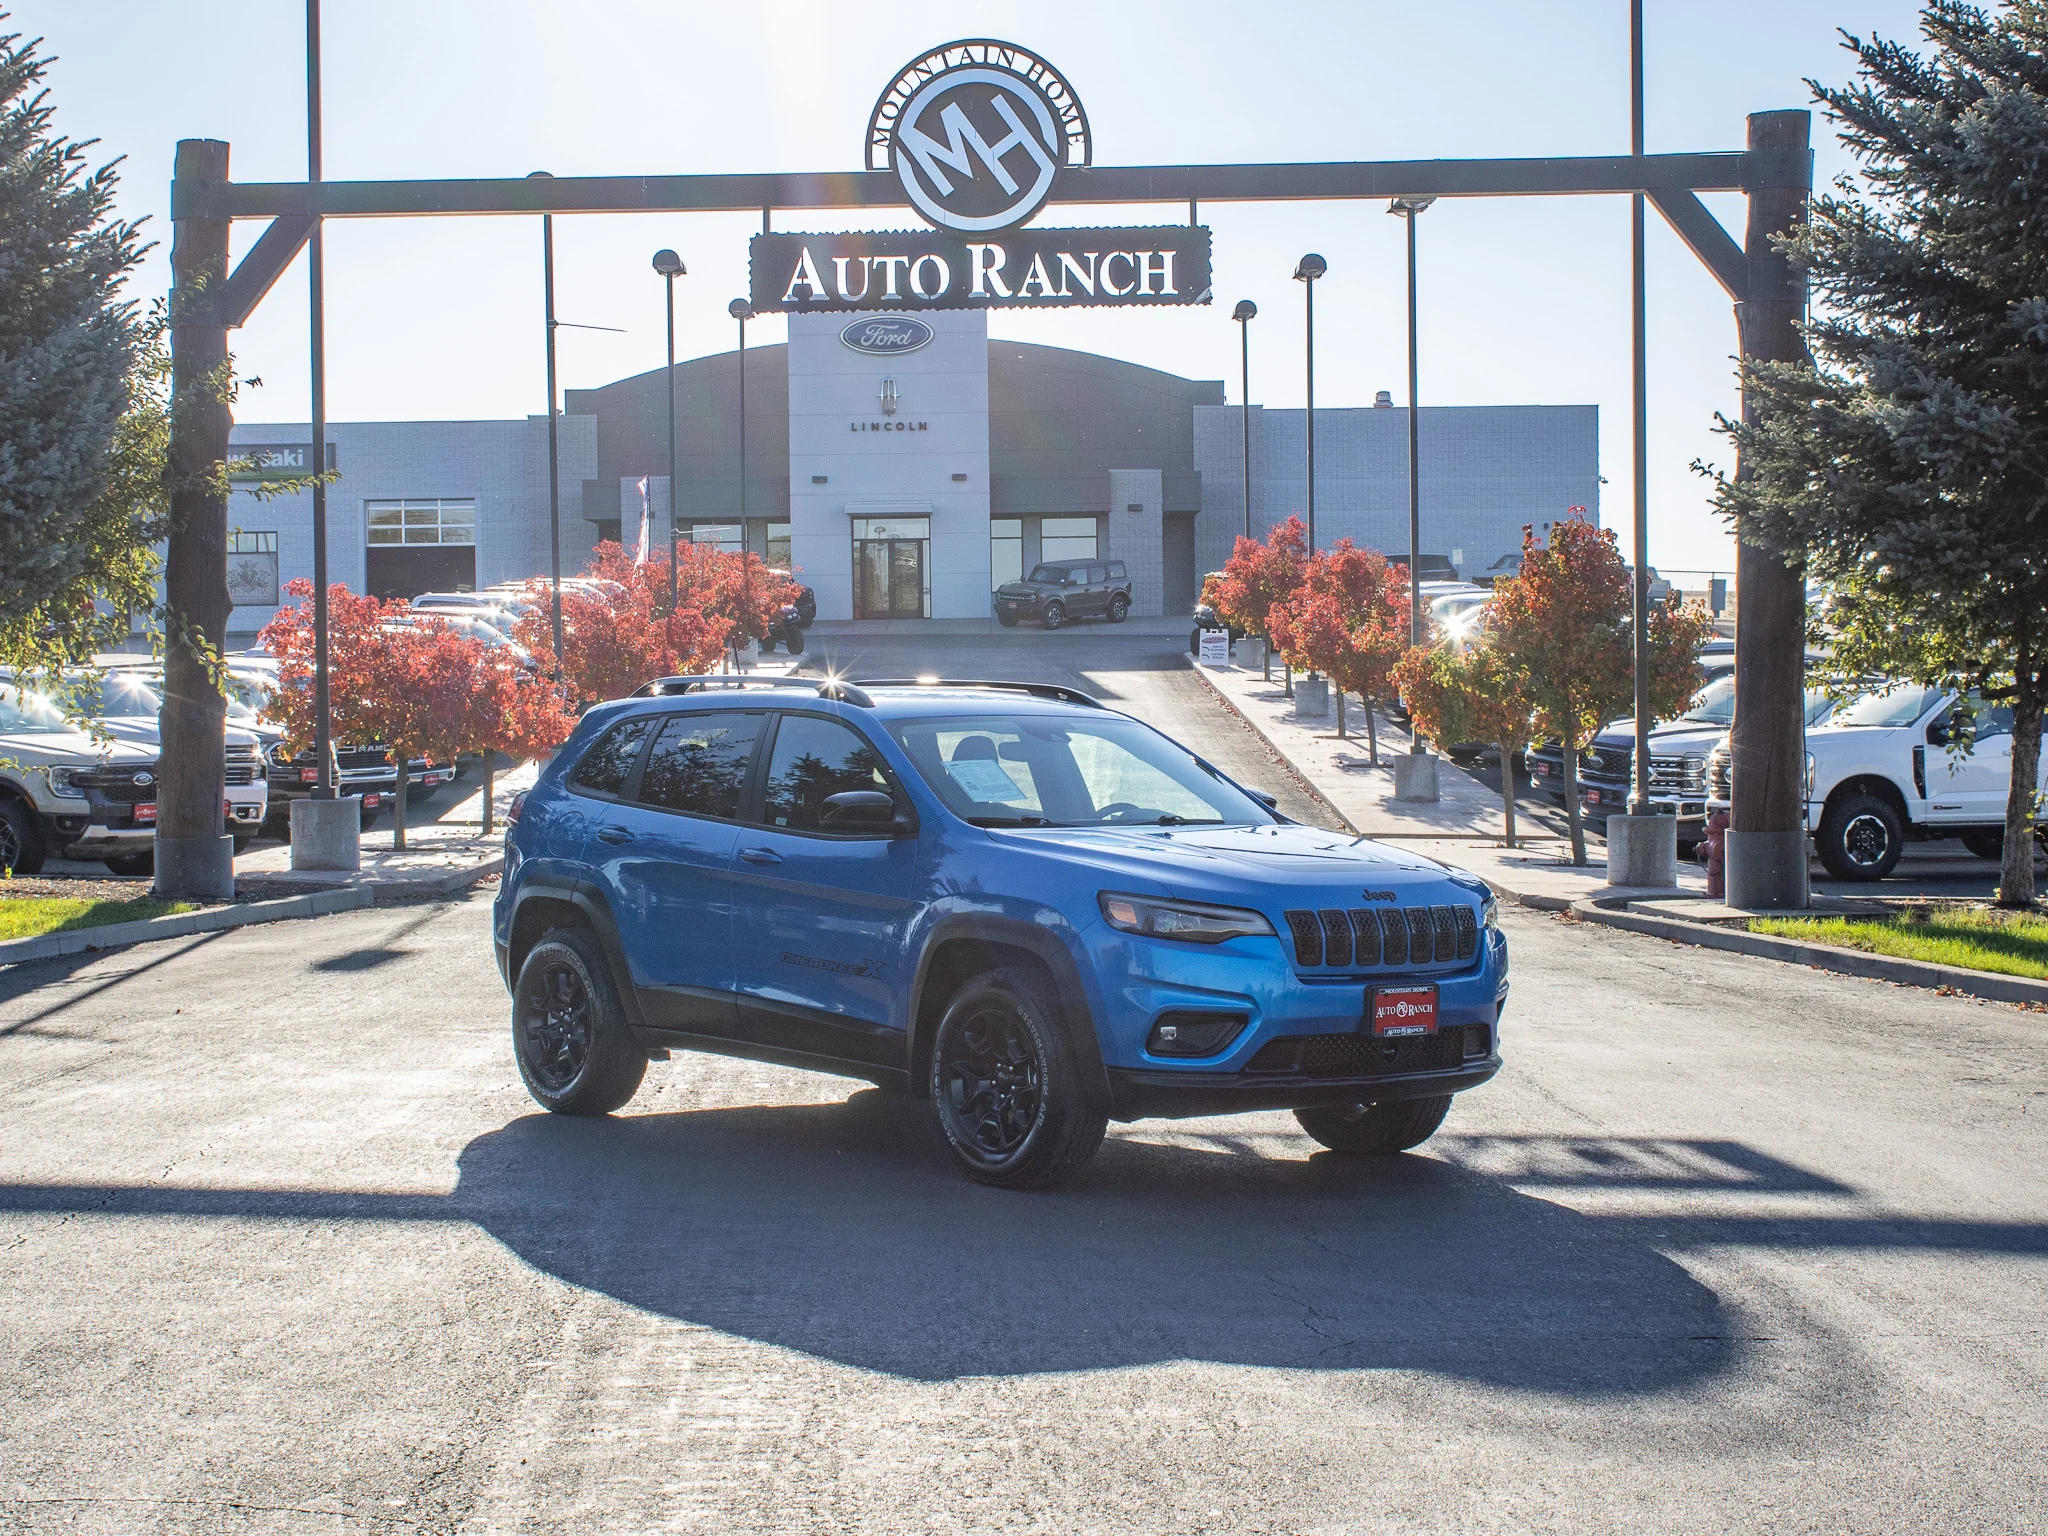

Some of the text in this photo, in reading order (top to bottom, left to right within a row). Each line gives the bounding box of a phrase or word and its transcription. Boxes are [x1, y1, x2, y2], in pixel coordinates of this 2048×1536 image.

[872, 44, 1085, 148] MOUNTAIN HOME
[781, 242, 1180, 303] AUTO RANCH
[860, 322, 913, 347] Ford
[850, 421, 928, 433] LINCOLN
[1361, 888, 1398, 903] Jeep
[779, 951, 858, 976] CHEROKEE
[1375, 1005, 1396, 1018] AUTO
[1408, 1004, 1433, 1016] RANCH
